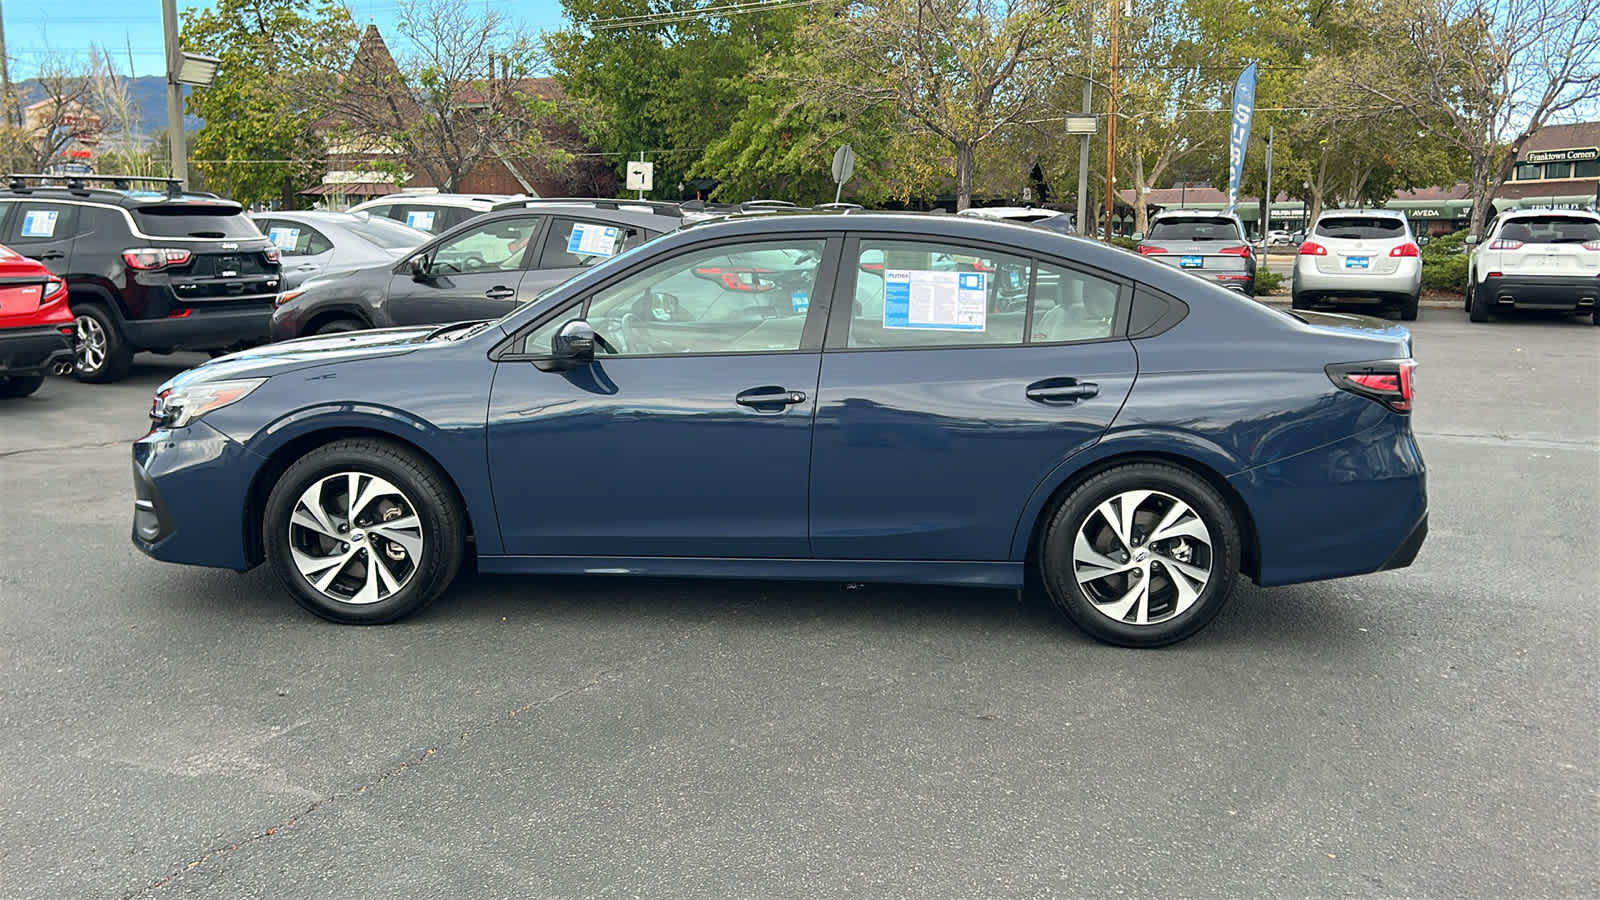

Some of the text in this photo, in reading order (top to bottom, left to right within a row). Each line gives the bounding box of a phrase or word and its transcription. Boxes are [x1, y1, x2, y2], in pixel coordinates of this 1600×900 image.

[1529, 151, 1596, 161] Franktown Corners
[1412, 209, 1440, 217] AVEDA
